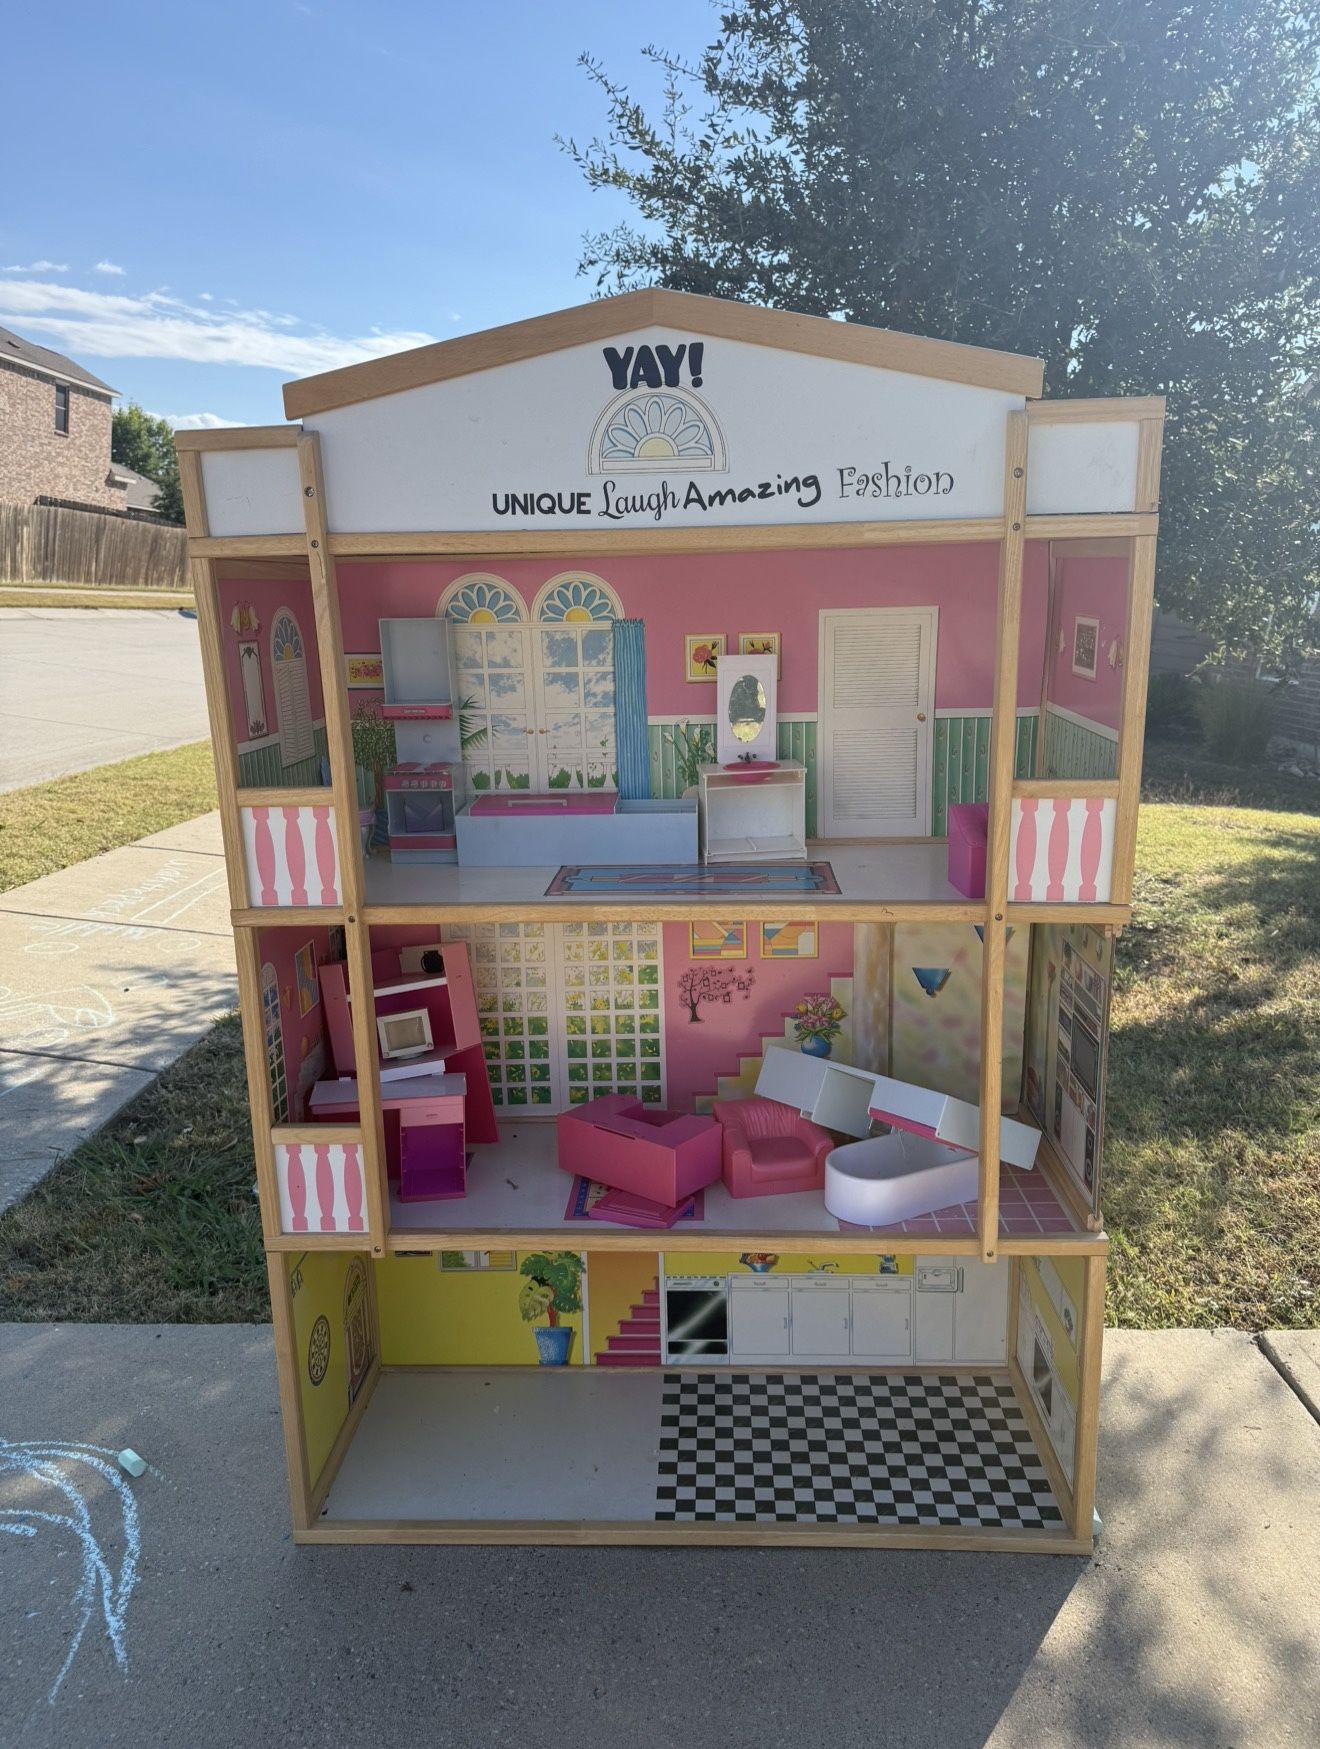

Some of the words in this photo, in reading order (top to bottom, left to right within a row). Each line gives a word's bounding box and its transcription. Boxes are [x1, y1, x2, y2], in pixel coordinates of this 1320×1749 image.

[602, 341, 705, 391] YAY!
[492, 492, 592, 516] UNIQUE
[598, 480, 681, 521] Laugh
[682, 473, 823, 509] Amazing
[836, 460, 955, 499] Fashion
